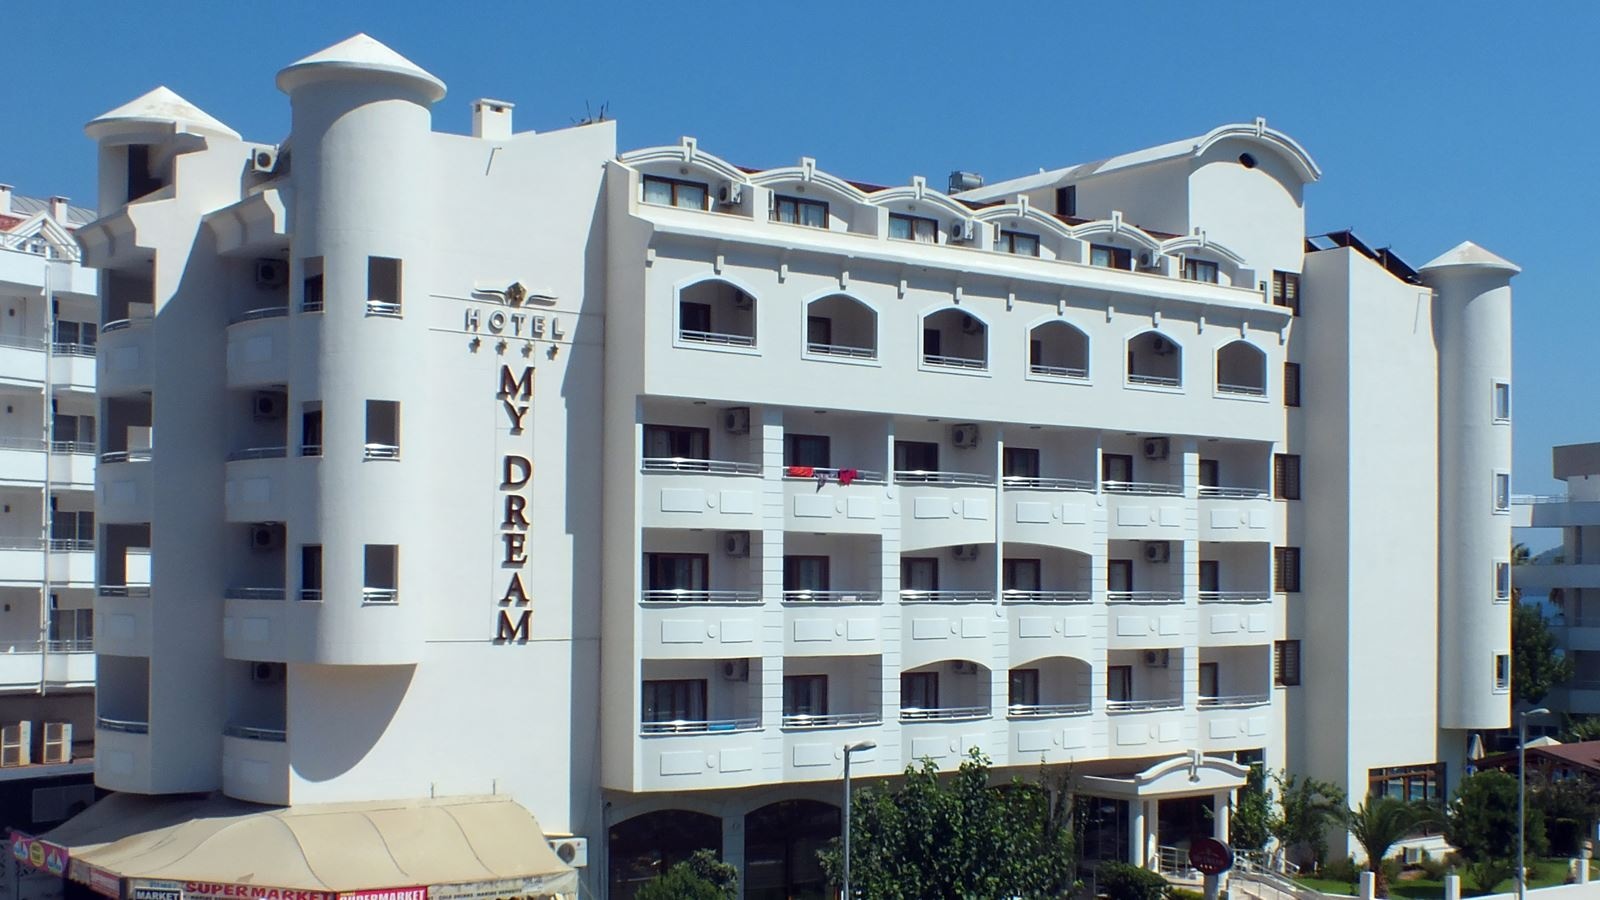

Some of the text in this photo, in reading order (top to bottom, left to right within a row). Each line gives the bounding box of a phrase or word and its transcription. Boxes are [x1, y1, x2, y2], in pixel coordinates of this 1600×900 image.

[465, 308, 565, 339] HOTEL
[495, 364, 535, 643] MY DREAM
